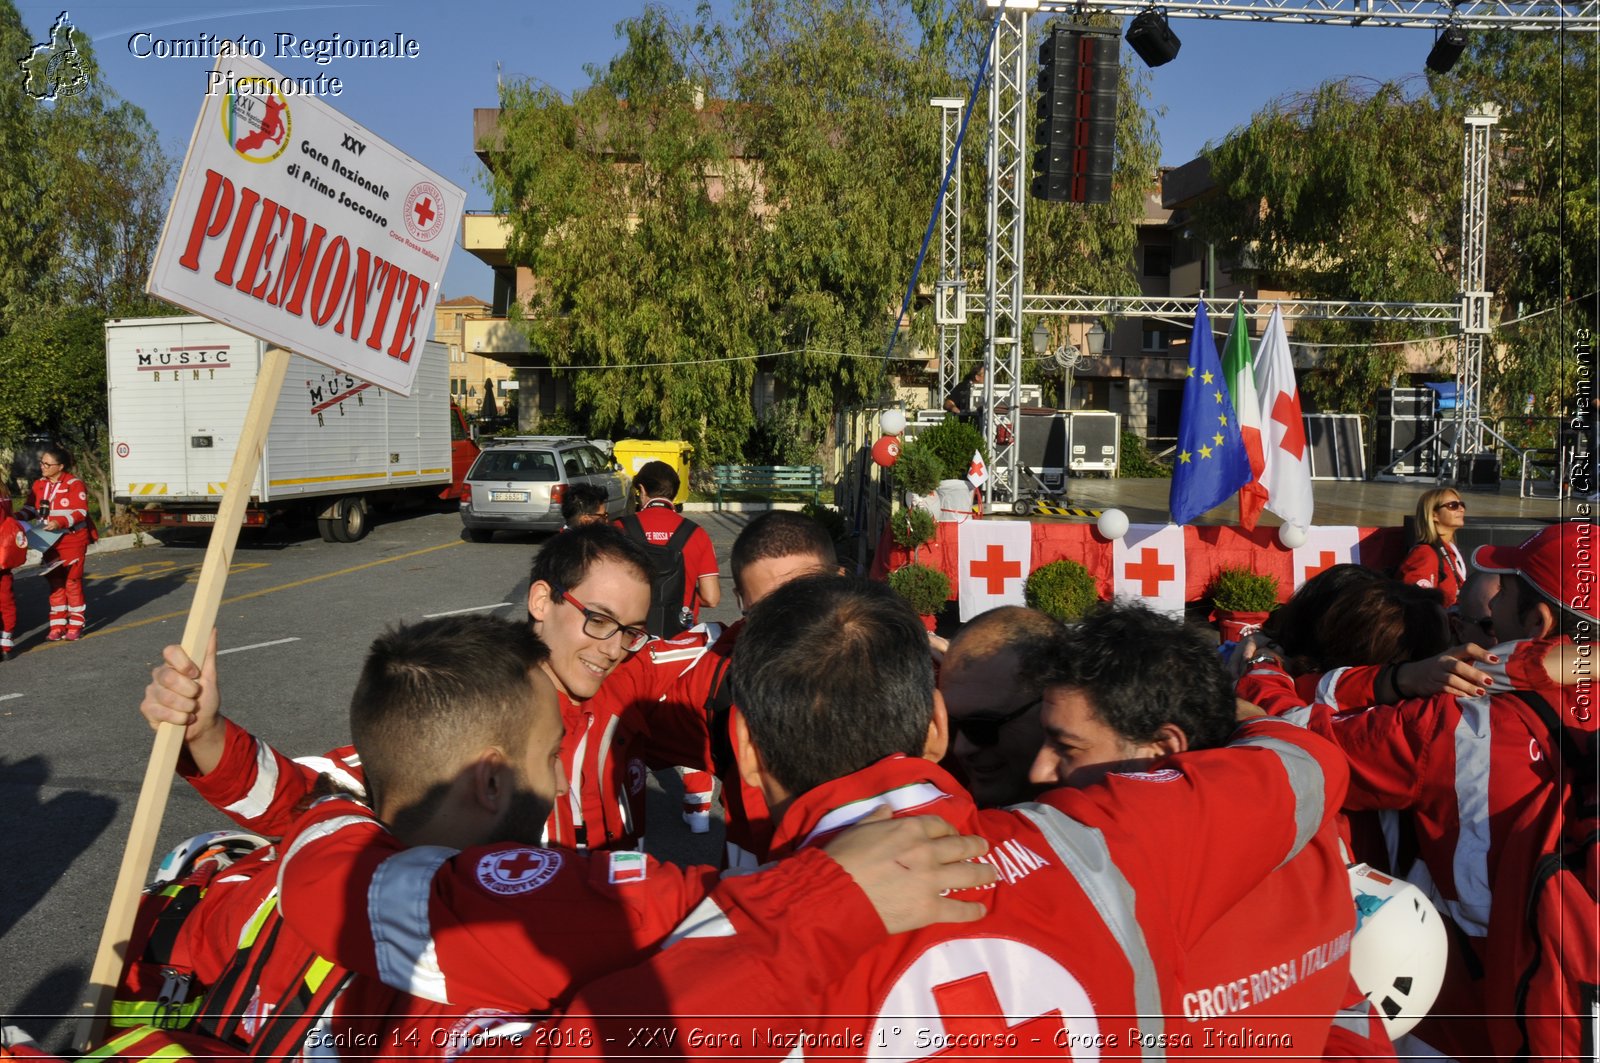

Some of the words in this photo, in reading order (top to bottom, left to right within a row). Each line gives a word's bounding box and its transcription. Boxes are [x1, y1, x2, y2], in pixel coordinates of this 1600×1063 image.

[341, 132, 367, 156] XXV
[301, 140, 329, 167] Gara
[331, 158, 390, 201] Nazionale
[287, 163, 301, 179] di
[302, 170, 336, 198] Primo
[338, 191, 388, 227] Soccorso
[179, 168, 431, 364] PIEMONTE
[389, 230, 405, 243] Croce
[405, 238, 421, 252] Rossa
[421, 246, 440, 262] Italiana
[154, 368, 215, 382] RENT
[310, 374, 363, 406] MUS
[1182, 978, 1250, 1023] CROCE
[1250, 959, 1297, 1005] ROSSA
